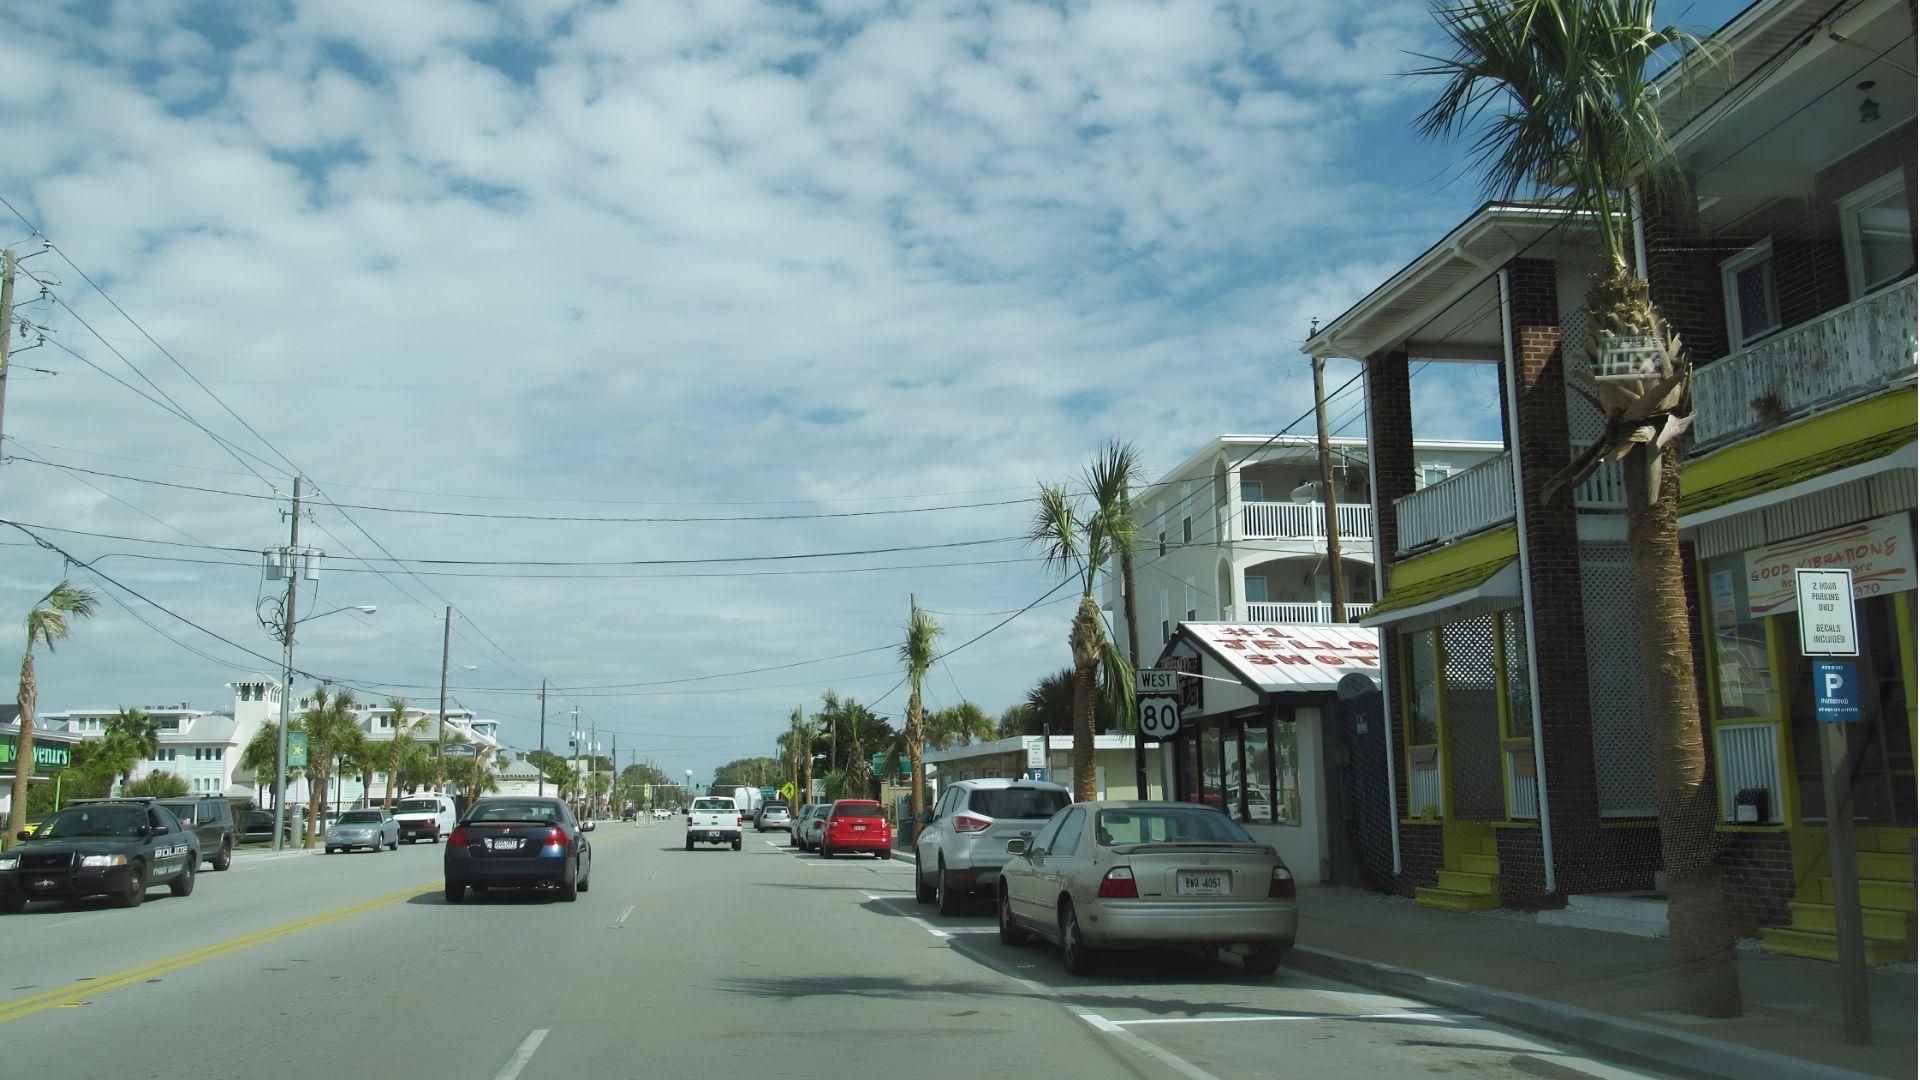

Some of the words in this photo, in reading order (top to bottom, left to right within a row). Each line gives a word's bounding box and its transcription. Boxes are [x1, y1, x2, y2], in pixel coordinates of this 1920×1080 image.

[1751, 563, 1790, 582] GOOD
[1798, 536, 1897, 569] VIBRATIONS
[1811, 593, 1840, 601] PARKING
[1818, 603, 1835, 612] ONLY
[1815, 623, 1841, 632] DECALS
[1213, 639, 1379, 651] JELLO
[1813, 635, 1845, 644] INCLUDED
[1141, 673, 1172, 687] WEST
[1825, 673, 1843, 698] P
[1143, 704, 1176, 731] 80
[154, 845, 189, 859] POLICE
